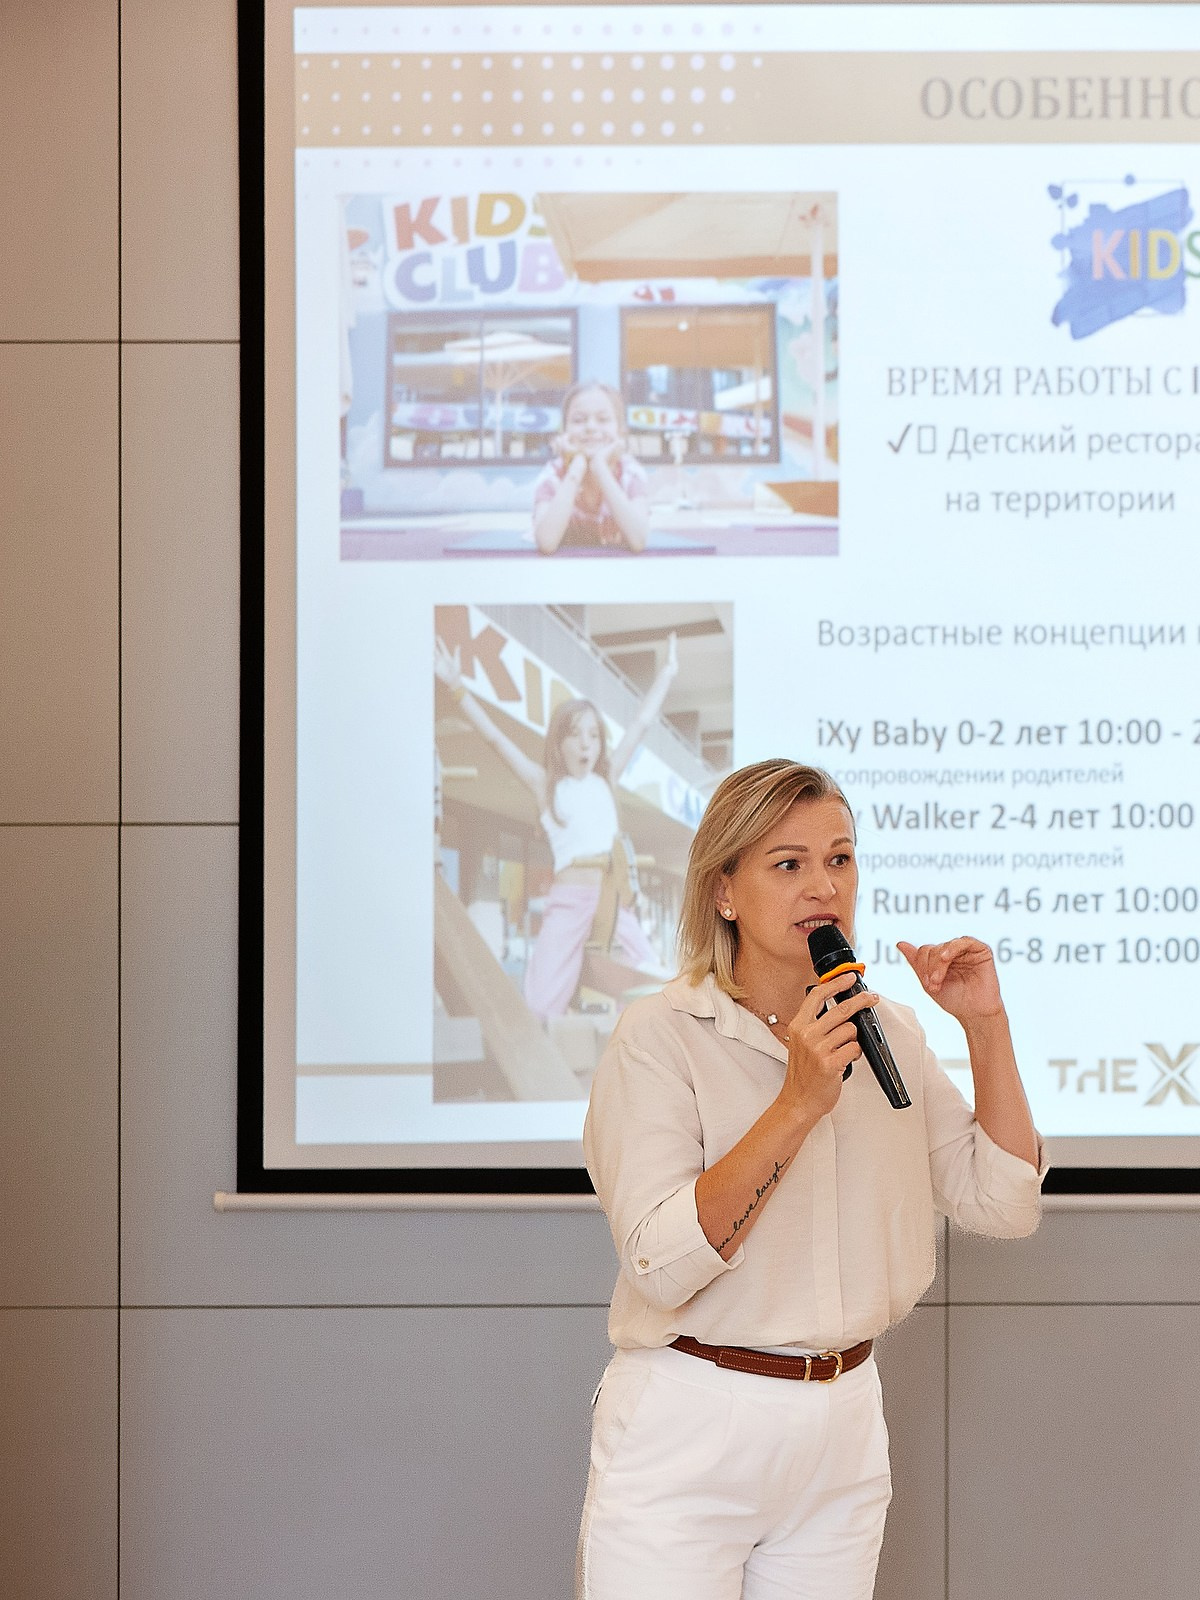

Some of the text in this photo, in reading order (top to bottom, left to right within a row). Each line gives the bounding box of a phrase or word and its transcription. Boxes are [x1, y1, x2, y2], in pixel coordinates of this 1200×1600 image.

[394, 239, 566, 303] CLUB
[886, 364, 1003, 398] ВРЕМЯ
[1013, 364, 1154, 398] РАБОТЫ
[1162, 365, 1183, 397] С
[946, 423, 1077, 462] Детский
[944, 489, 1176, 520] на территории
[816, 618, 1003, 654] Возрастные
[1013, 622, 1187, 653] концепции
[817, 717, 863, 755] iXy
[871, 717, 949, 755] Baby
[956, 718, 1006, 747] 0-2
[1013, 723, 1069, 748] лет
[1078, 717, 1163, 747] 10:00
[1010, 765, 1125, 790] родителей
[871, 800, 982, 831] Walker
[989, 802, 1038, 831] 2-4
[1046, 807, 1101, 832] лет
[1110, 801, 1195, 831] 10:00
[859, 849, 1126, 874] провождении родителей
[872, 886, 985, 915] Runner
[993, 885, 1043, 915] 4-6
[1051, 891, 1105, 915] лет
[1115, 885, 1200, 914] 10:00
[996, 936, 1044, 965] 6-8
[1052, 941, 1107, 966] лет
[1047, 1058, 1138, 1094] THE
